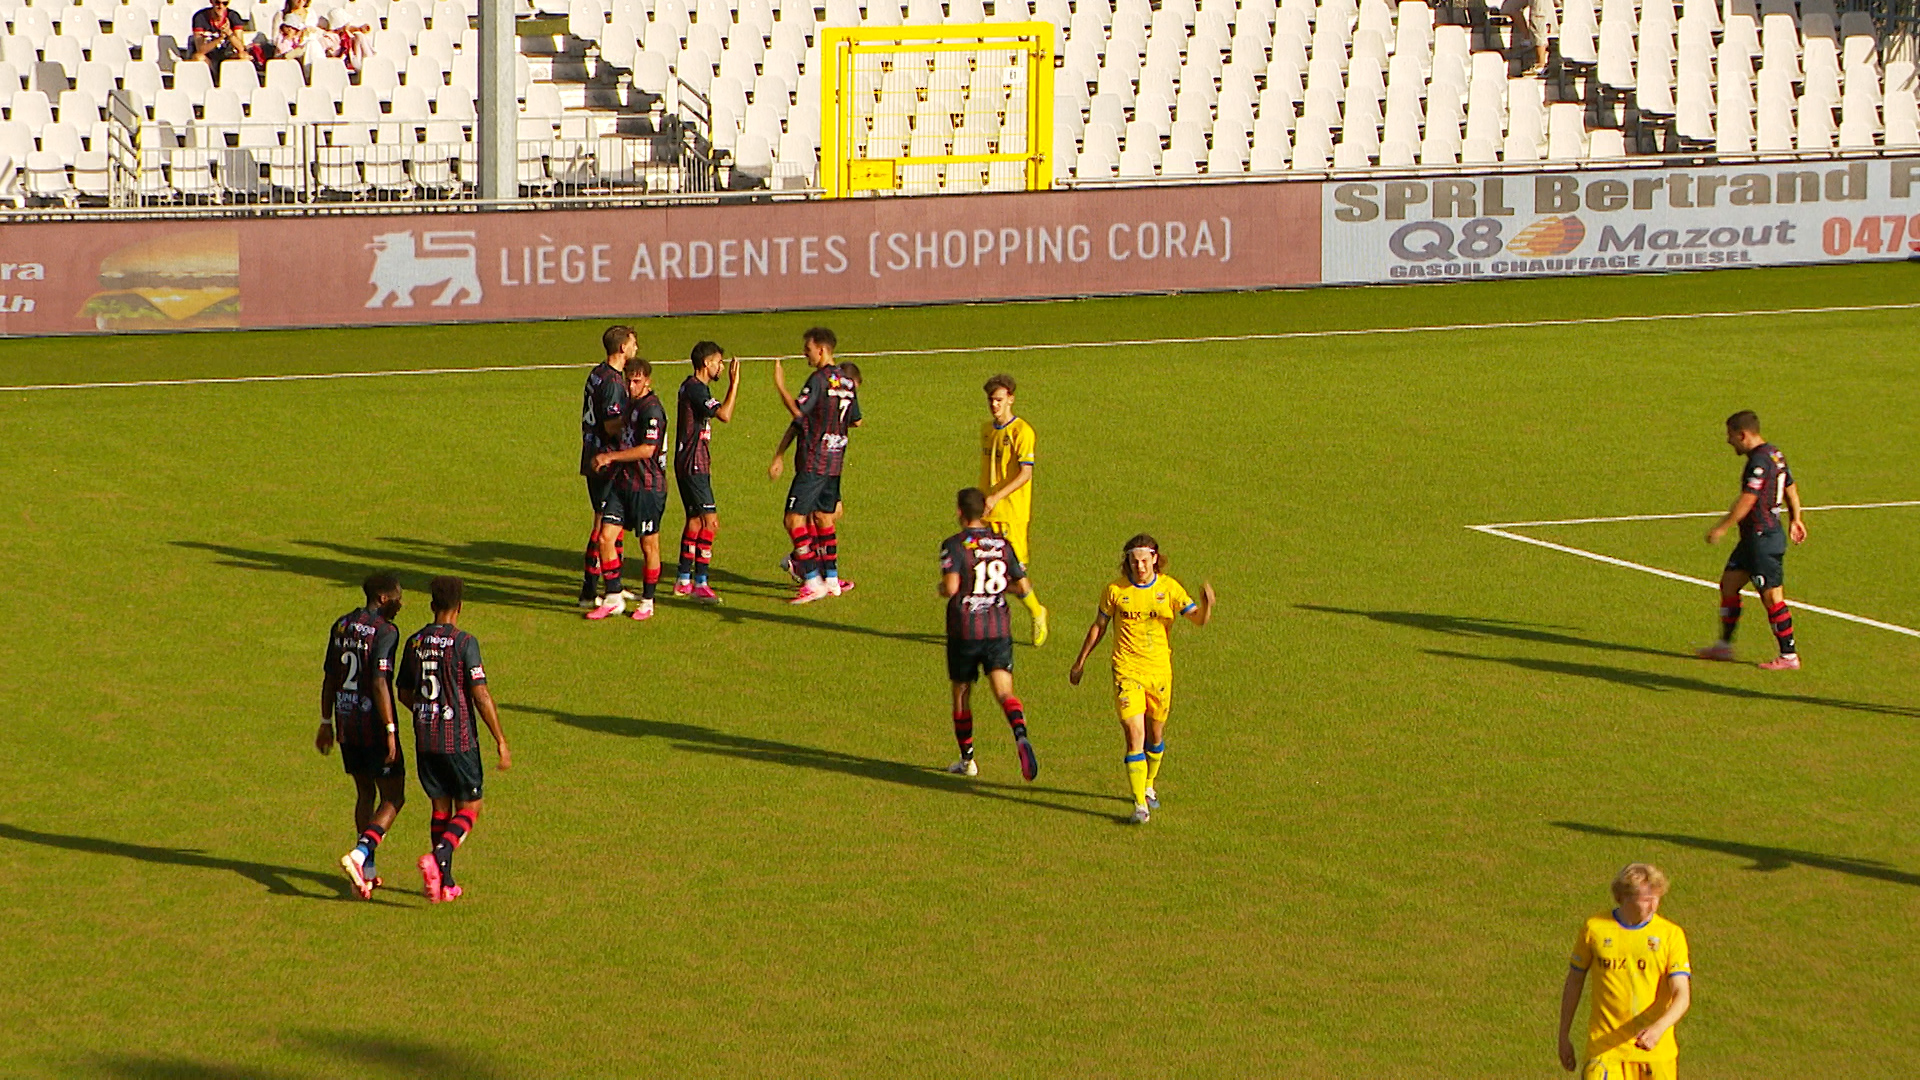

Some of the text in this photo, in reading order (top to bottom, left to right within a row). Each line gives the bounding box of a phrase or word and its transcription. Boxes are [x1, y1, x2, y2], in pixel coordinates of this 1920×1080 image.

[1334, 177, 1515, 222] SPRL
[1534, 162, 1868, 215] Bertrand
[1389, 217, 1504, 261] Q8
[1597, 219, 1796, 252] Mazout
[500, 234, 612, 286] LIÈGE
[630, 235, 848, 281] ARDENTES
[1390, 262, 1484, 278] GASOIL
[1491, 254, 1640, 273] CHAUFFAGE
[1666, 250, 1752, 266] DIESEL
[839, 398, 852, 423] 7
[972, 560, 1008, 595] 18
[341, 651, 358, 690] 2
[421, 661, 441, 700] 5
